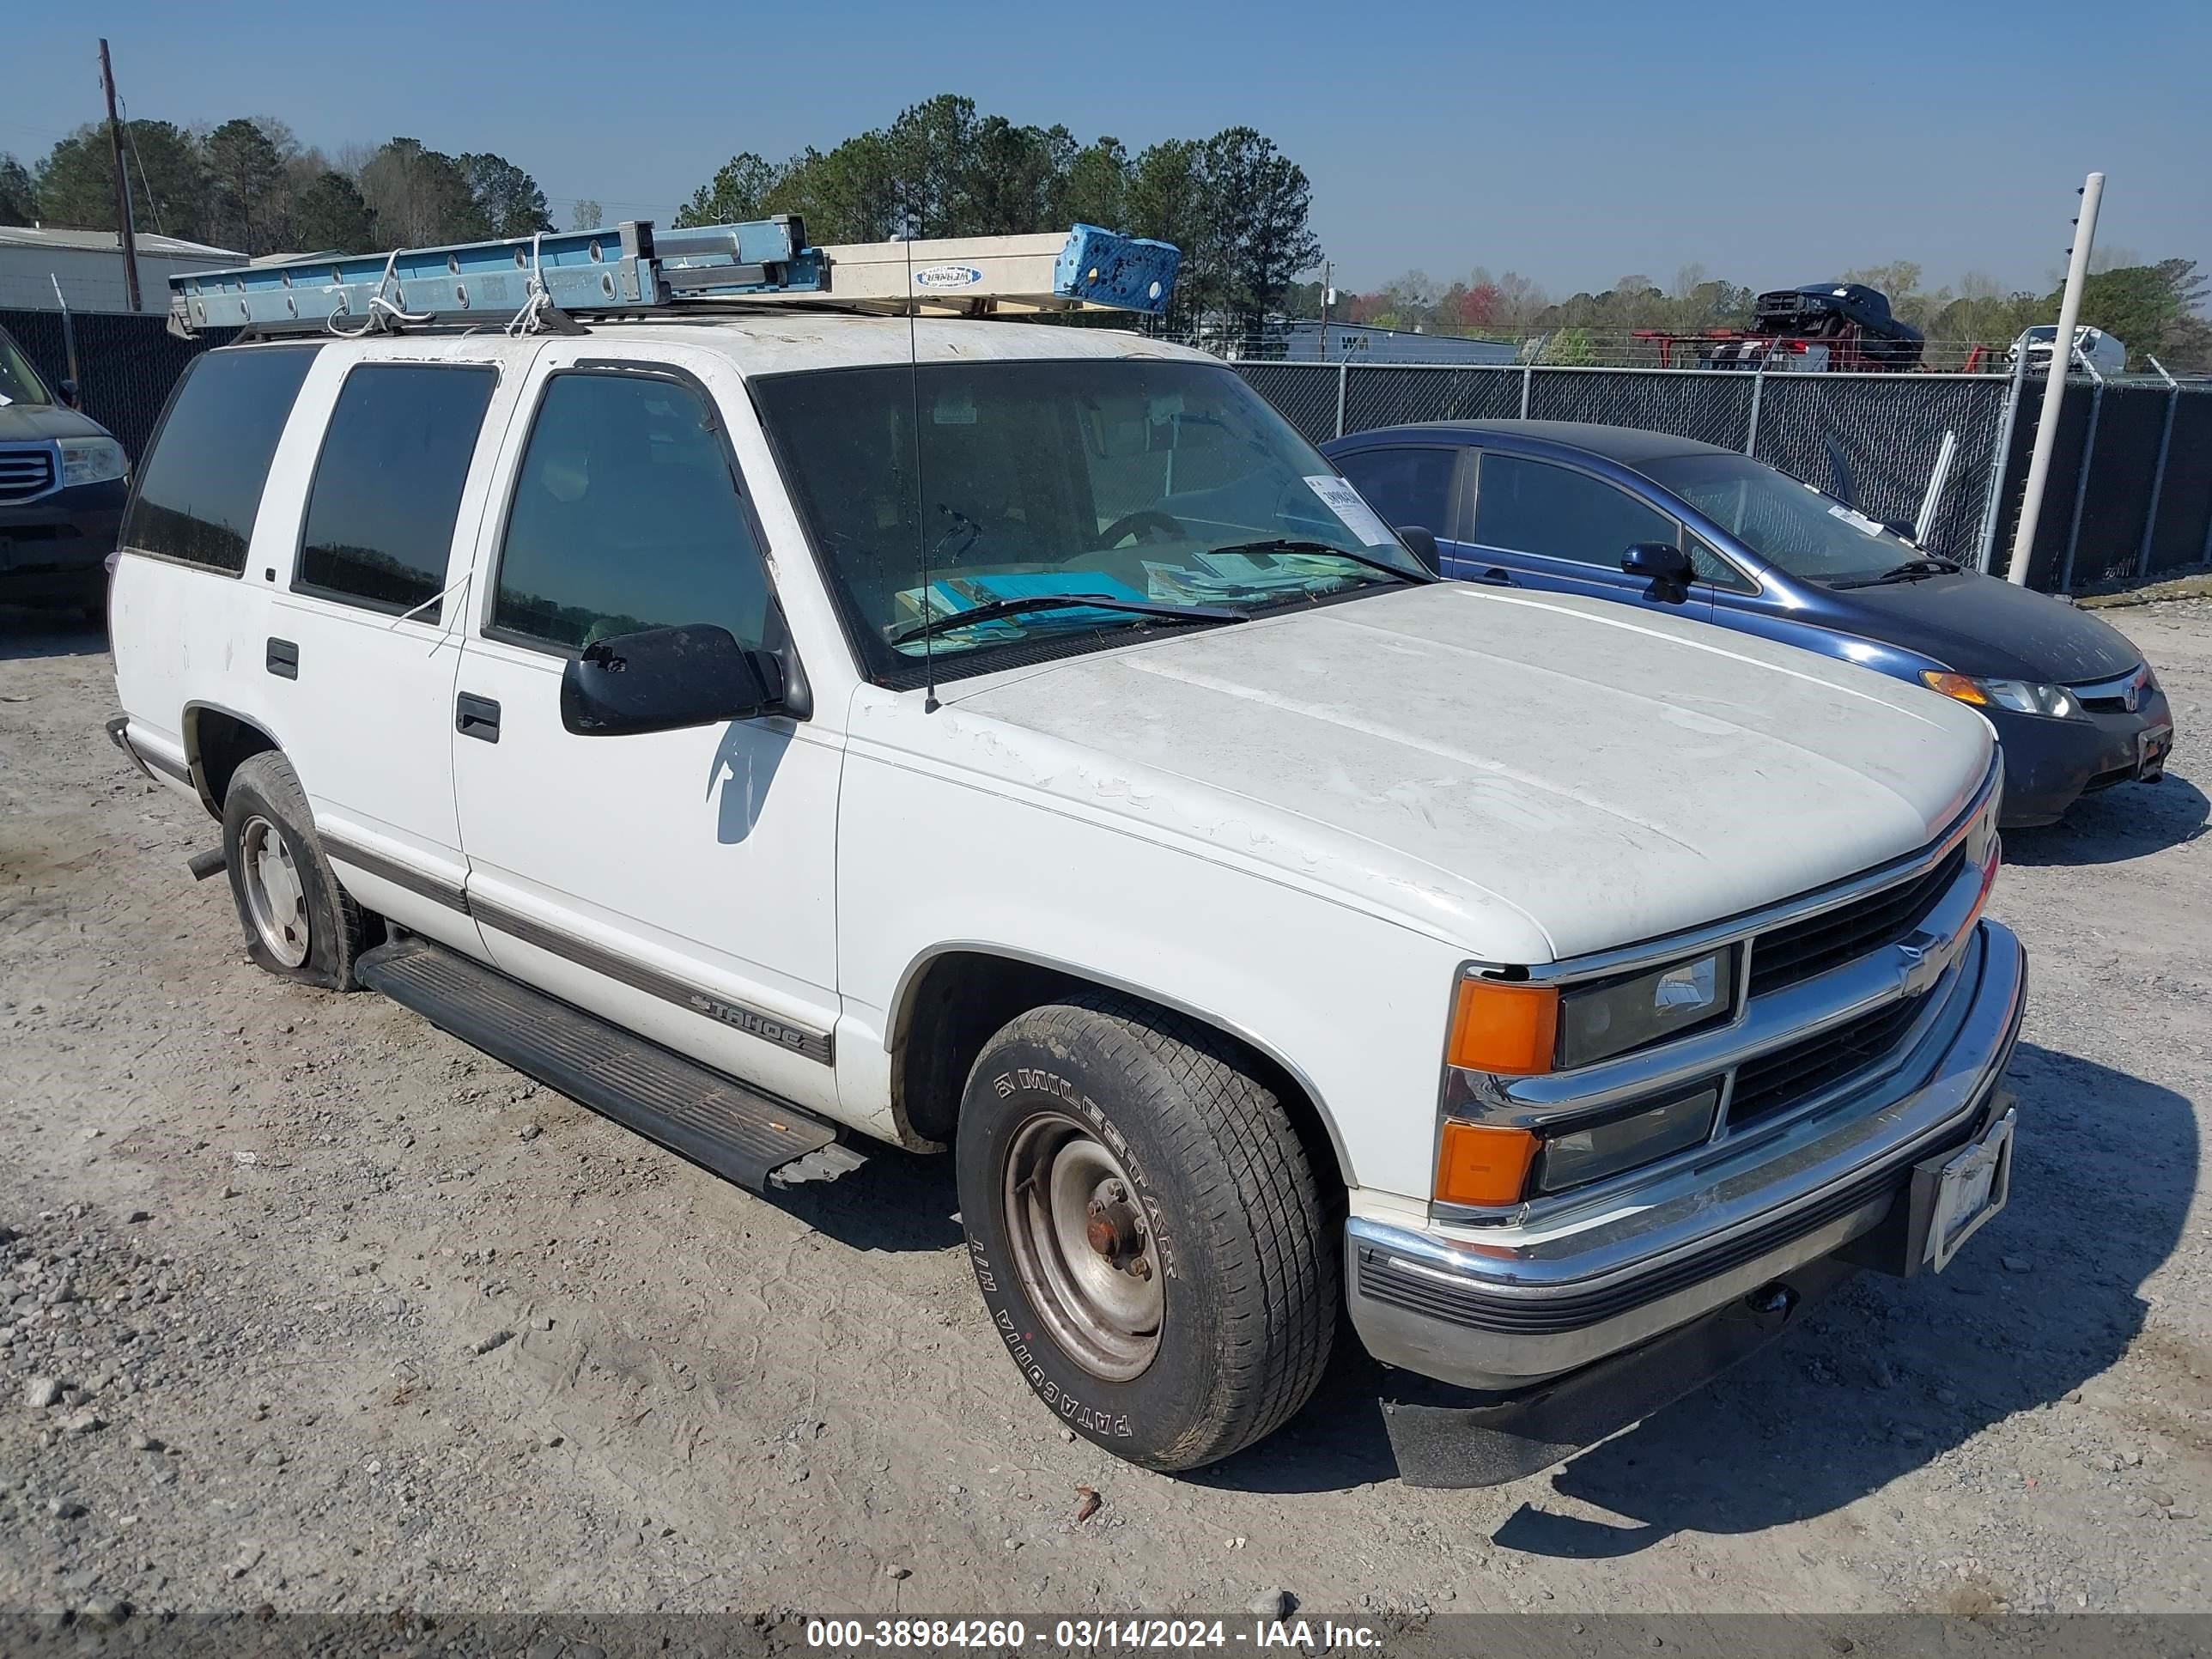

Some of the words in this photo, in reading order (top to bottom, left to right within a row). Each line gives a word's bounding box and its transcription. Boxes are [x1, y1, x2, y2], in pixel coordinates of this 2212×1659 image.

[926, 271, 969, 283] WERNER
[711, 1001, 805, 1050] TAHOE
[1017, 1067, 1179, 1279] MILESTAR
[969, 1231, 998, 1292] H/T
[995, 1309, 1133, 1437] PATAGONIA
